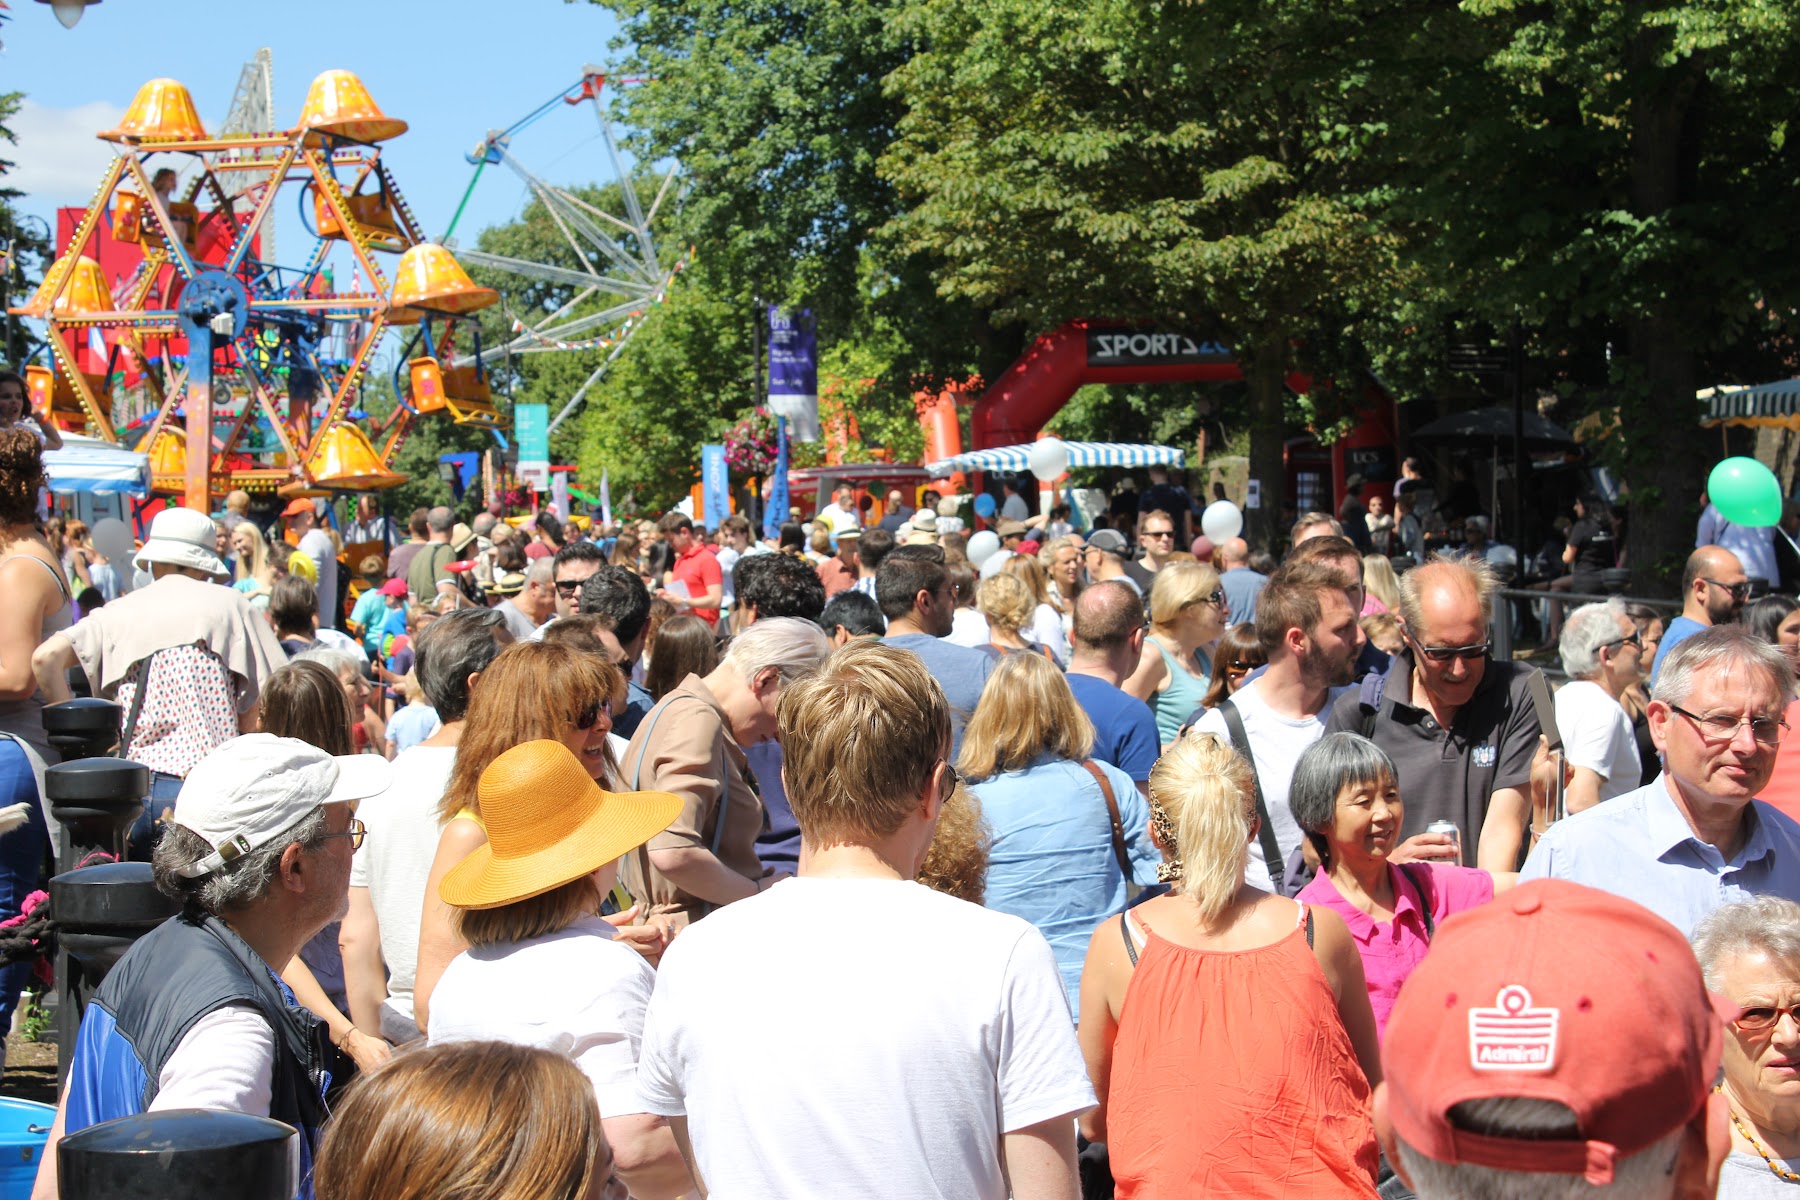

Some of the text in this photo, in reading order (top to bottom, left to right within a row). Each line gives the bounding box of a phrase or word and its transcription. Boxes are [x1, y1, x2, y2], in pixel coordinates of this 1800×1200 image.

[1353, 451, 1378, 464] UCS
[710, 451, 720, 491] ZONE
[1480, 1045, 1545, 1062] Admiral
